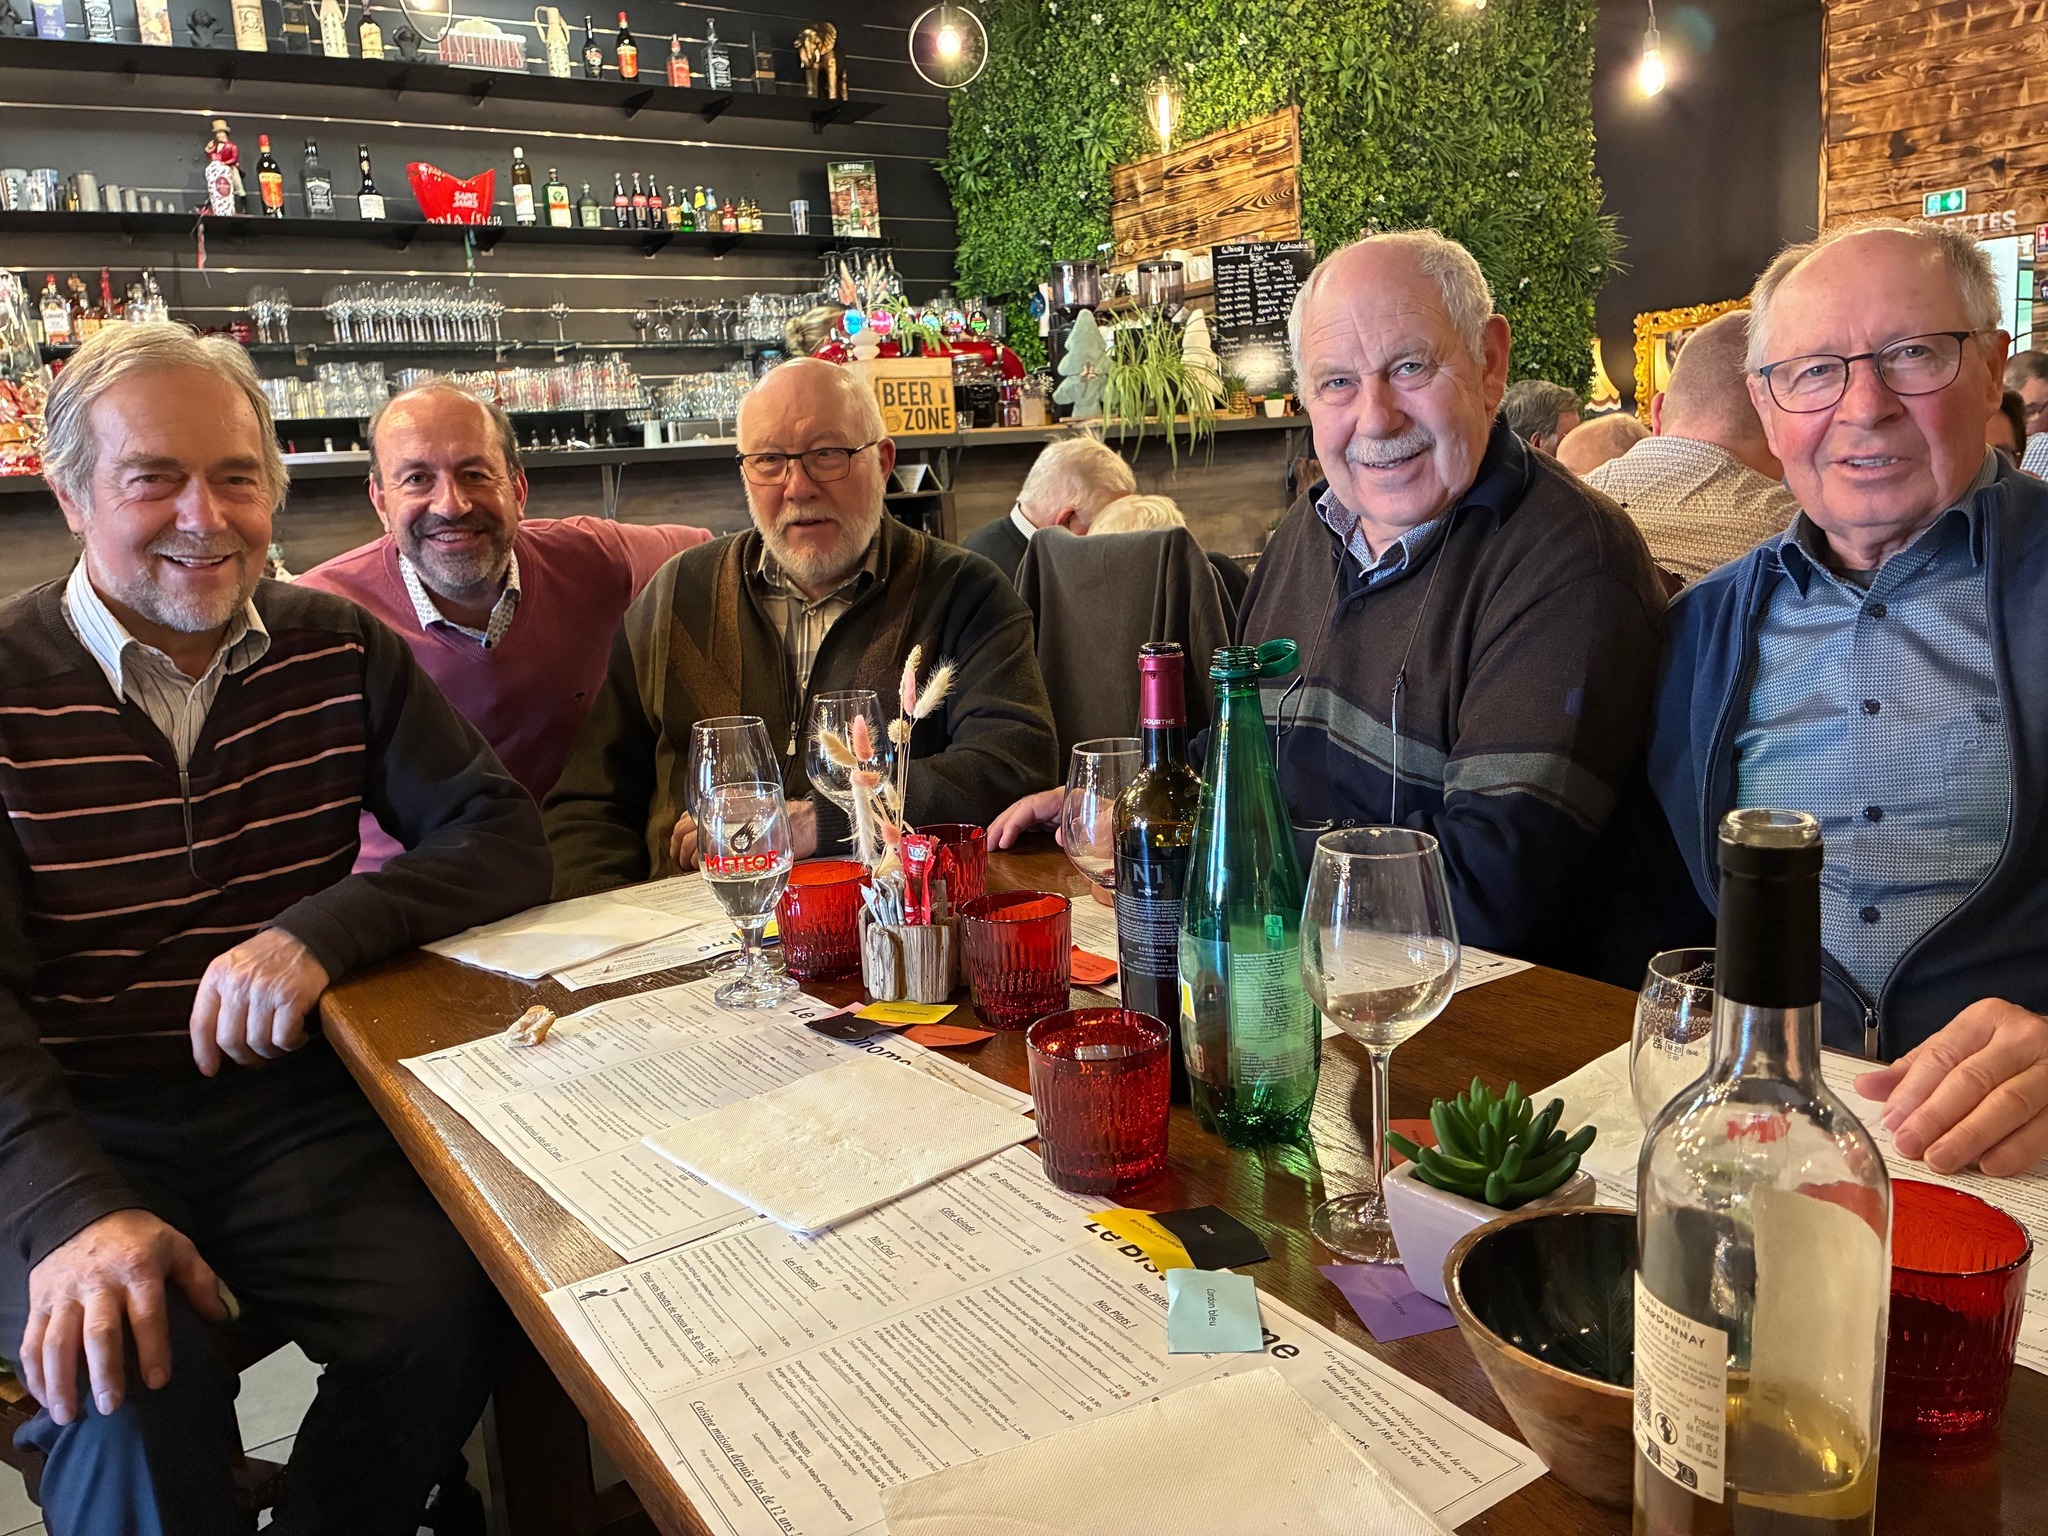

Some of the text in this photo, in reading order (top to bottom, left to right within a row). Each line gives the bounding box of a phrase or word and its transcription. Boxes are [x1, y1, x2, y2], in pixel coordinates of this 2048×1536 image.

[882, 382, 932, 407] BEER
[904, 407, 951, 431] ZONE
[1143, 717, 1175, 726] DOURTHE
[704, 850, 779, 874] METEOR
[791, 1007, 816, 1020] Le
[938, 1207, 959, 1219] Côté
[952, 1217, 975, 1232] Salade
[867, 1235, 884, 1247] Nos
[878, 1244, 896, 1256] Crus
[782, 1257, 797, 1267] Les
[639, 1271, 654, 1283] Pour
[648, 1282, 661, 1292] vos
[1132, 1282, 1152, 1294] Nos
[654, 1290, 672, 1307] bouts
[1206, 1288, 1217, 1327] Cordon bleu
[665, 1306, 677, 1314] de
[1092, 1299, 1112, 1313] Nos
[1107, 1310, 1131, 1326] Plats
[670, 1313, 688, 1328] choux
[1639, 1296, 1706, 1349] CHARDONNAY
[684, 1327, 694, 1335] de
[1323, 1365, 1349, 1385] Moules
[689, 1400, 716, 1427] Cuisine
[1323, 1350, 1337, 1360] Les
[1331, 1360, 1356, 1377] jeudis
[1353, 1376, 1373, 1391] soirs
[1419, 1436, 1442, 1450] plus
[1439, 1450, 1452, 1458] de
[1449, 1458, 1461, 1466] la
[1458, 1466, 1482, 1483] carte
[709, 1427, 735, 1453] maison
[1376, 1428, 1394, 1440] 18h
[727, 1454, 754, 1480] depuis
[745, 1478, 766, 1497] plus
[761, 1495, 775, 1504] de
[767, 1505, 786, 1516] 12
[778, 1517, 795, 1532] ans
